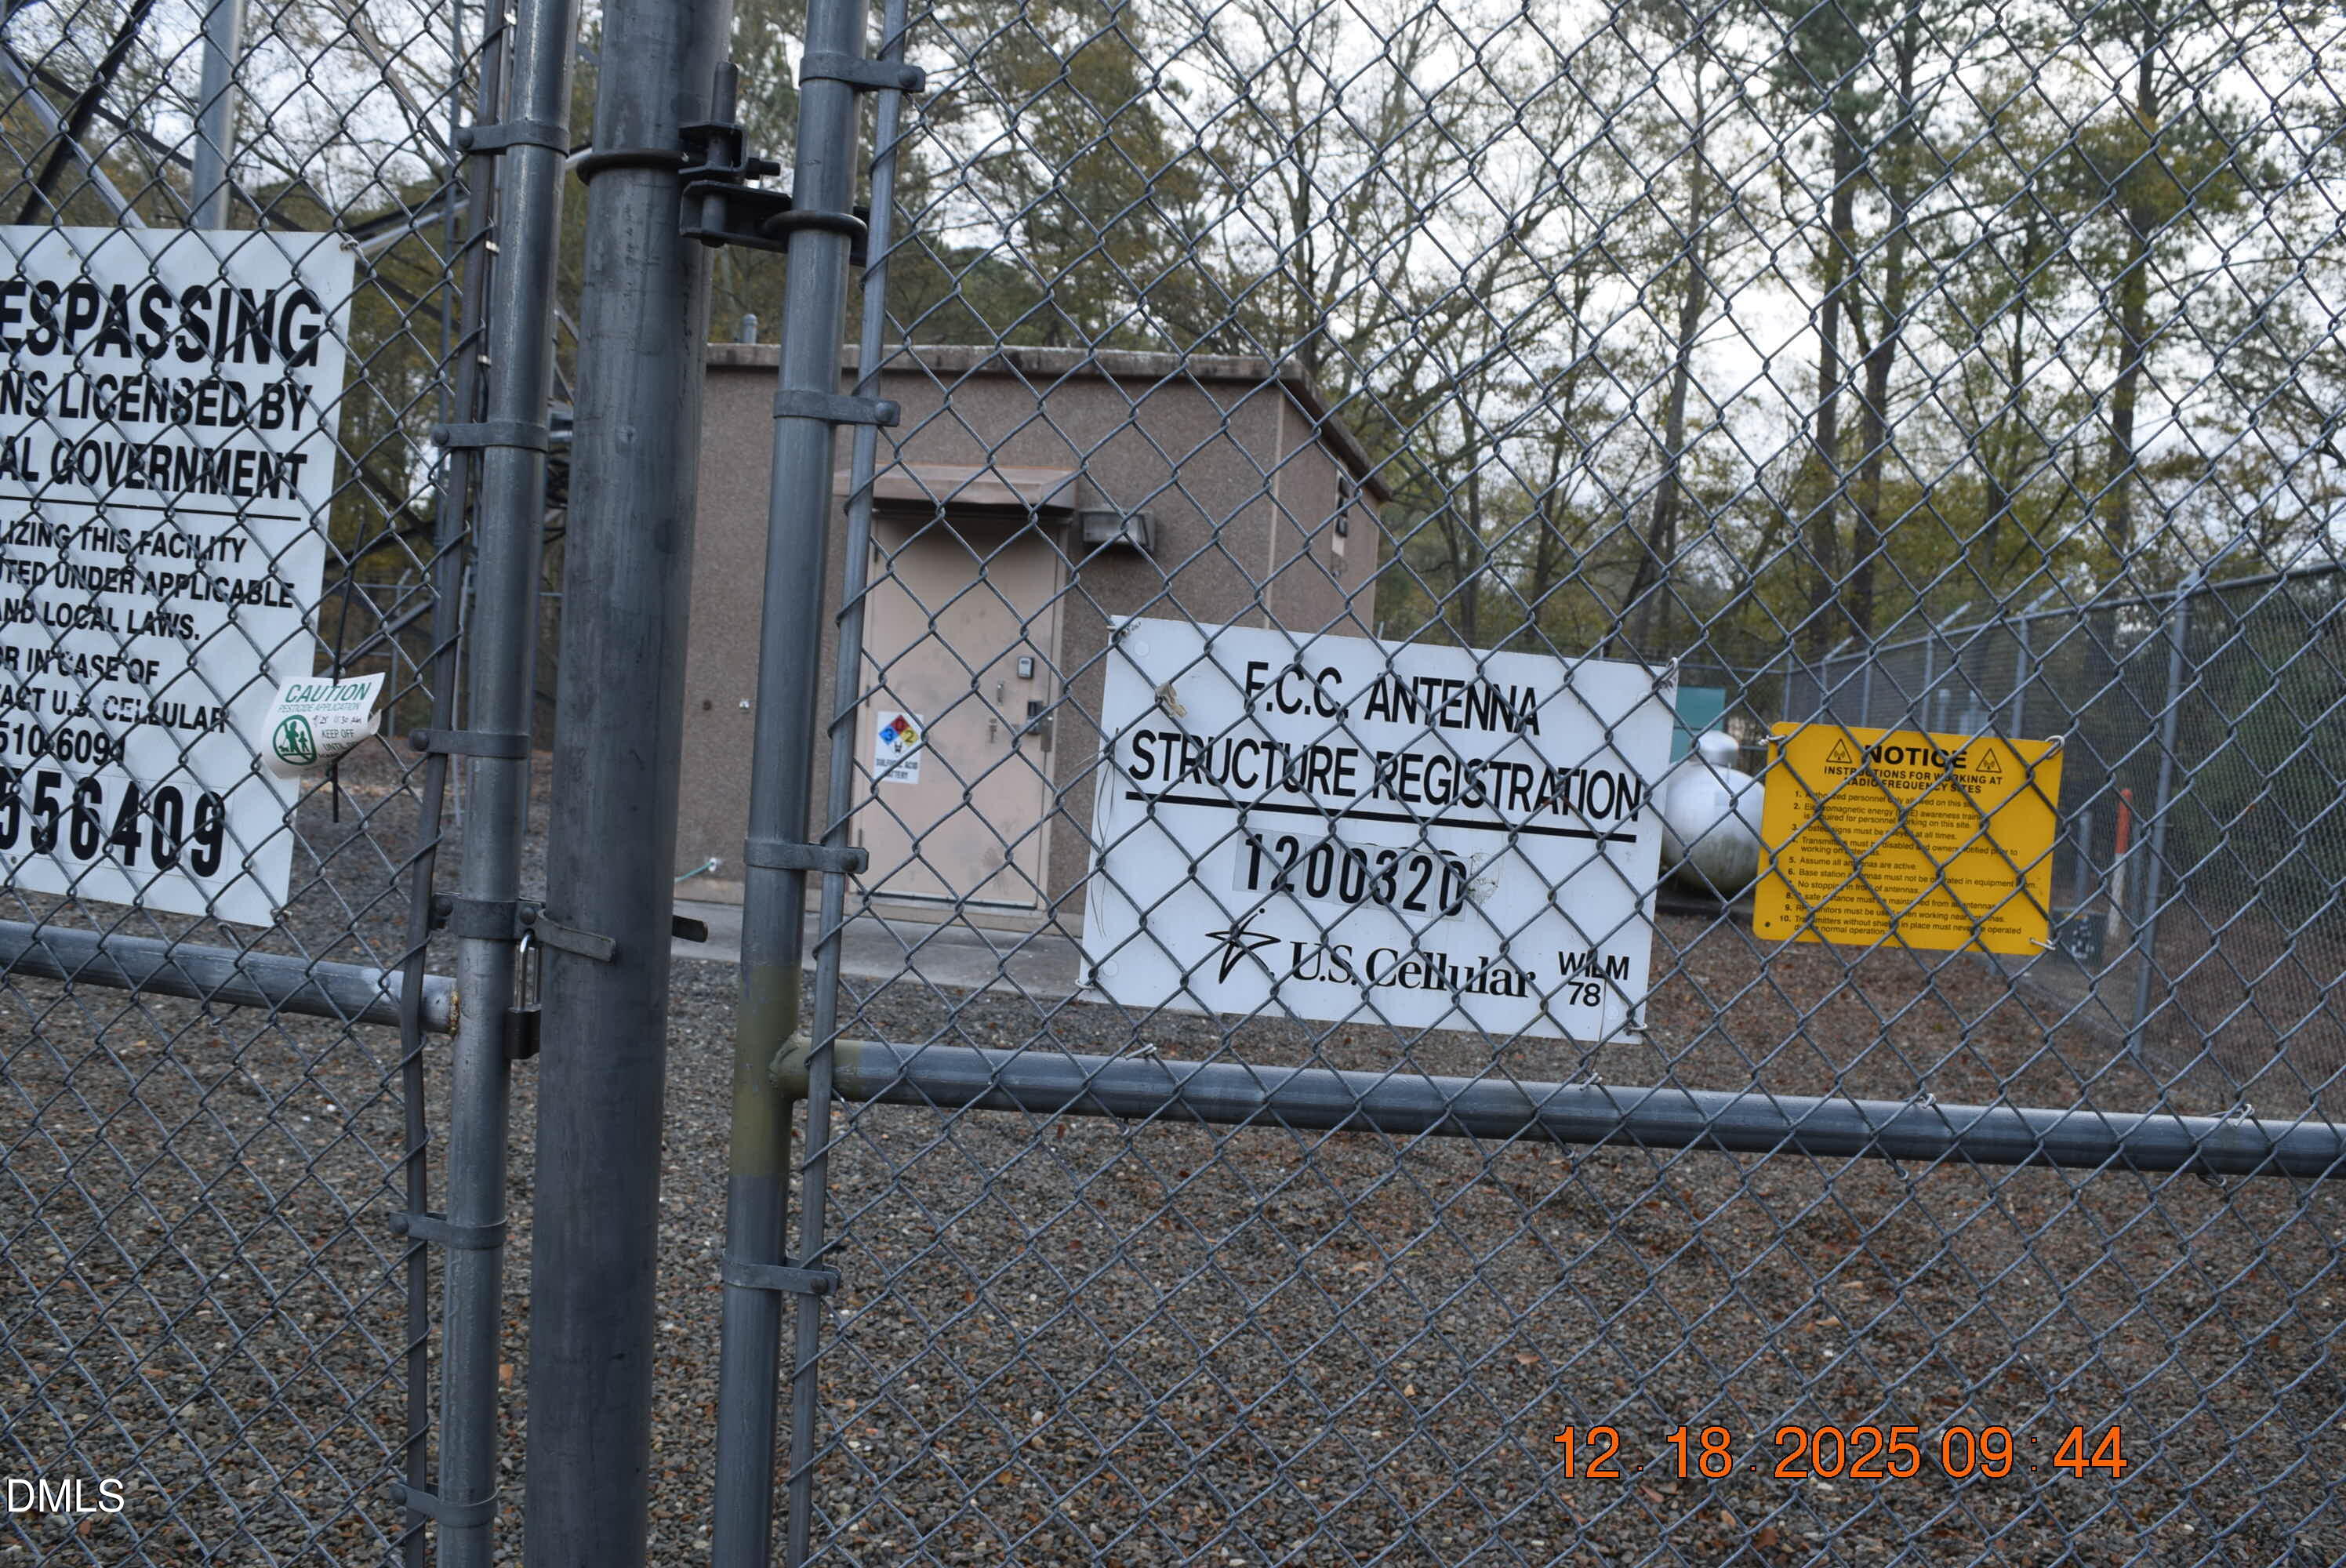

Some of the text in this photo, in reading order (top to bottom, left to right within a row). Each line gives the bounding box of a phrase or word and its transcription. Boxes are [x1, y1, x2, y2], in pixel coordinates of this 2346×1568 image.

[0, 280, 321, 367] ESPASSING
[60, 372, 247, 427] LICENSED
[260, 382, 312, 431] BY
[51, 437, 307, 500] GOVERNMENT
[78, 525, 132, 554] THIS
[139, 530, 247, 563] FACILITY
[0, 558, 295, 608] TED UNDER APPLICABLE
[44, 601, 119, 633] LOCAL
[127, 609, 200, 641] LAWS.
[27, 648, 50, 673] IN
[57, 651, 119, 681] CASE
[127, 658, 160, 685] OF
[0, 684, 46, 712] ACT
[285, 681, 372, 703] CAUTION
[1244, 660, 1540, 736] F.C.C. ANTENNA
[0, 721, 125, 766] 5106091
[321, 728, 354, 739] KEEP OFF
[885, 727, 914, 743] 3 2
[1864, 744, 1967, 769] NOTICE
[1128, 728, 1641, 822] STRUCTURE REGISTRATION
[1844, 777, 1879, 787] ADIO
[1950, 783, 1982, 794] STES
[1909, 771, 1931, 781] FOR
[1989, 776, 2003, 785] AT
[1848, 793, 1886, 804] personnel
[1905, 797, 1934, 805] allwed
[1948, 798, 1961, 808] this
[1868, 808, 1894, 818] energy
[1858, 815, 1896, 826] personnel
[1244, 833, 1467, 917] 1200320
[1798, 880, 1810, 888] No
[1799, 868, 1819, 877] Base
[1289, 940, 1538, 998] U.S. Cellular
[1567, 981, 1601, 1007] 78
